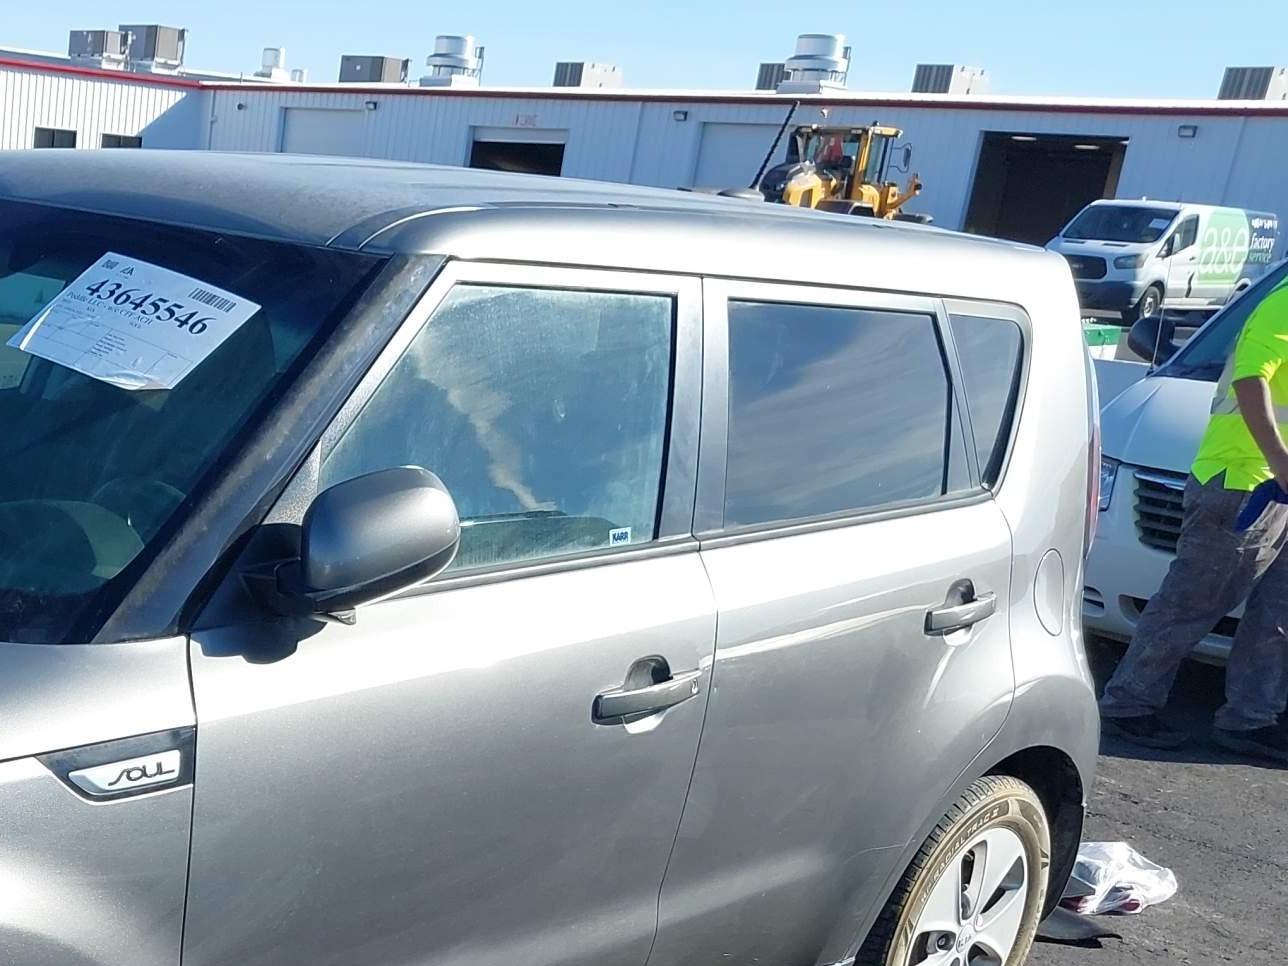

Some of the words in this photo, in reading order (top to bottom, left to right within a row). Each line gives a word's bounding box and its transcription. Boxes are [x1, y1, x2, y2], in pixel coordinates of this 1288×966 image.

[1249, 232, 1275, 254] factory
[85, 279, 216, 335] 43645546
[108, 762, 175, 787] SOUL
[967, 815, 991, 836] TRAC
